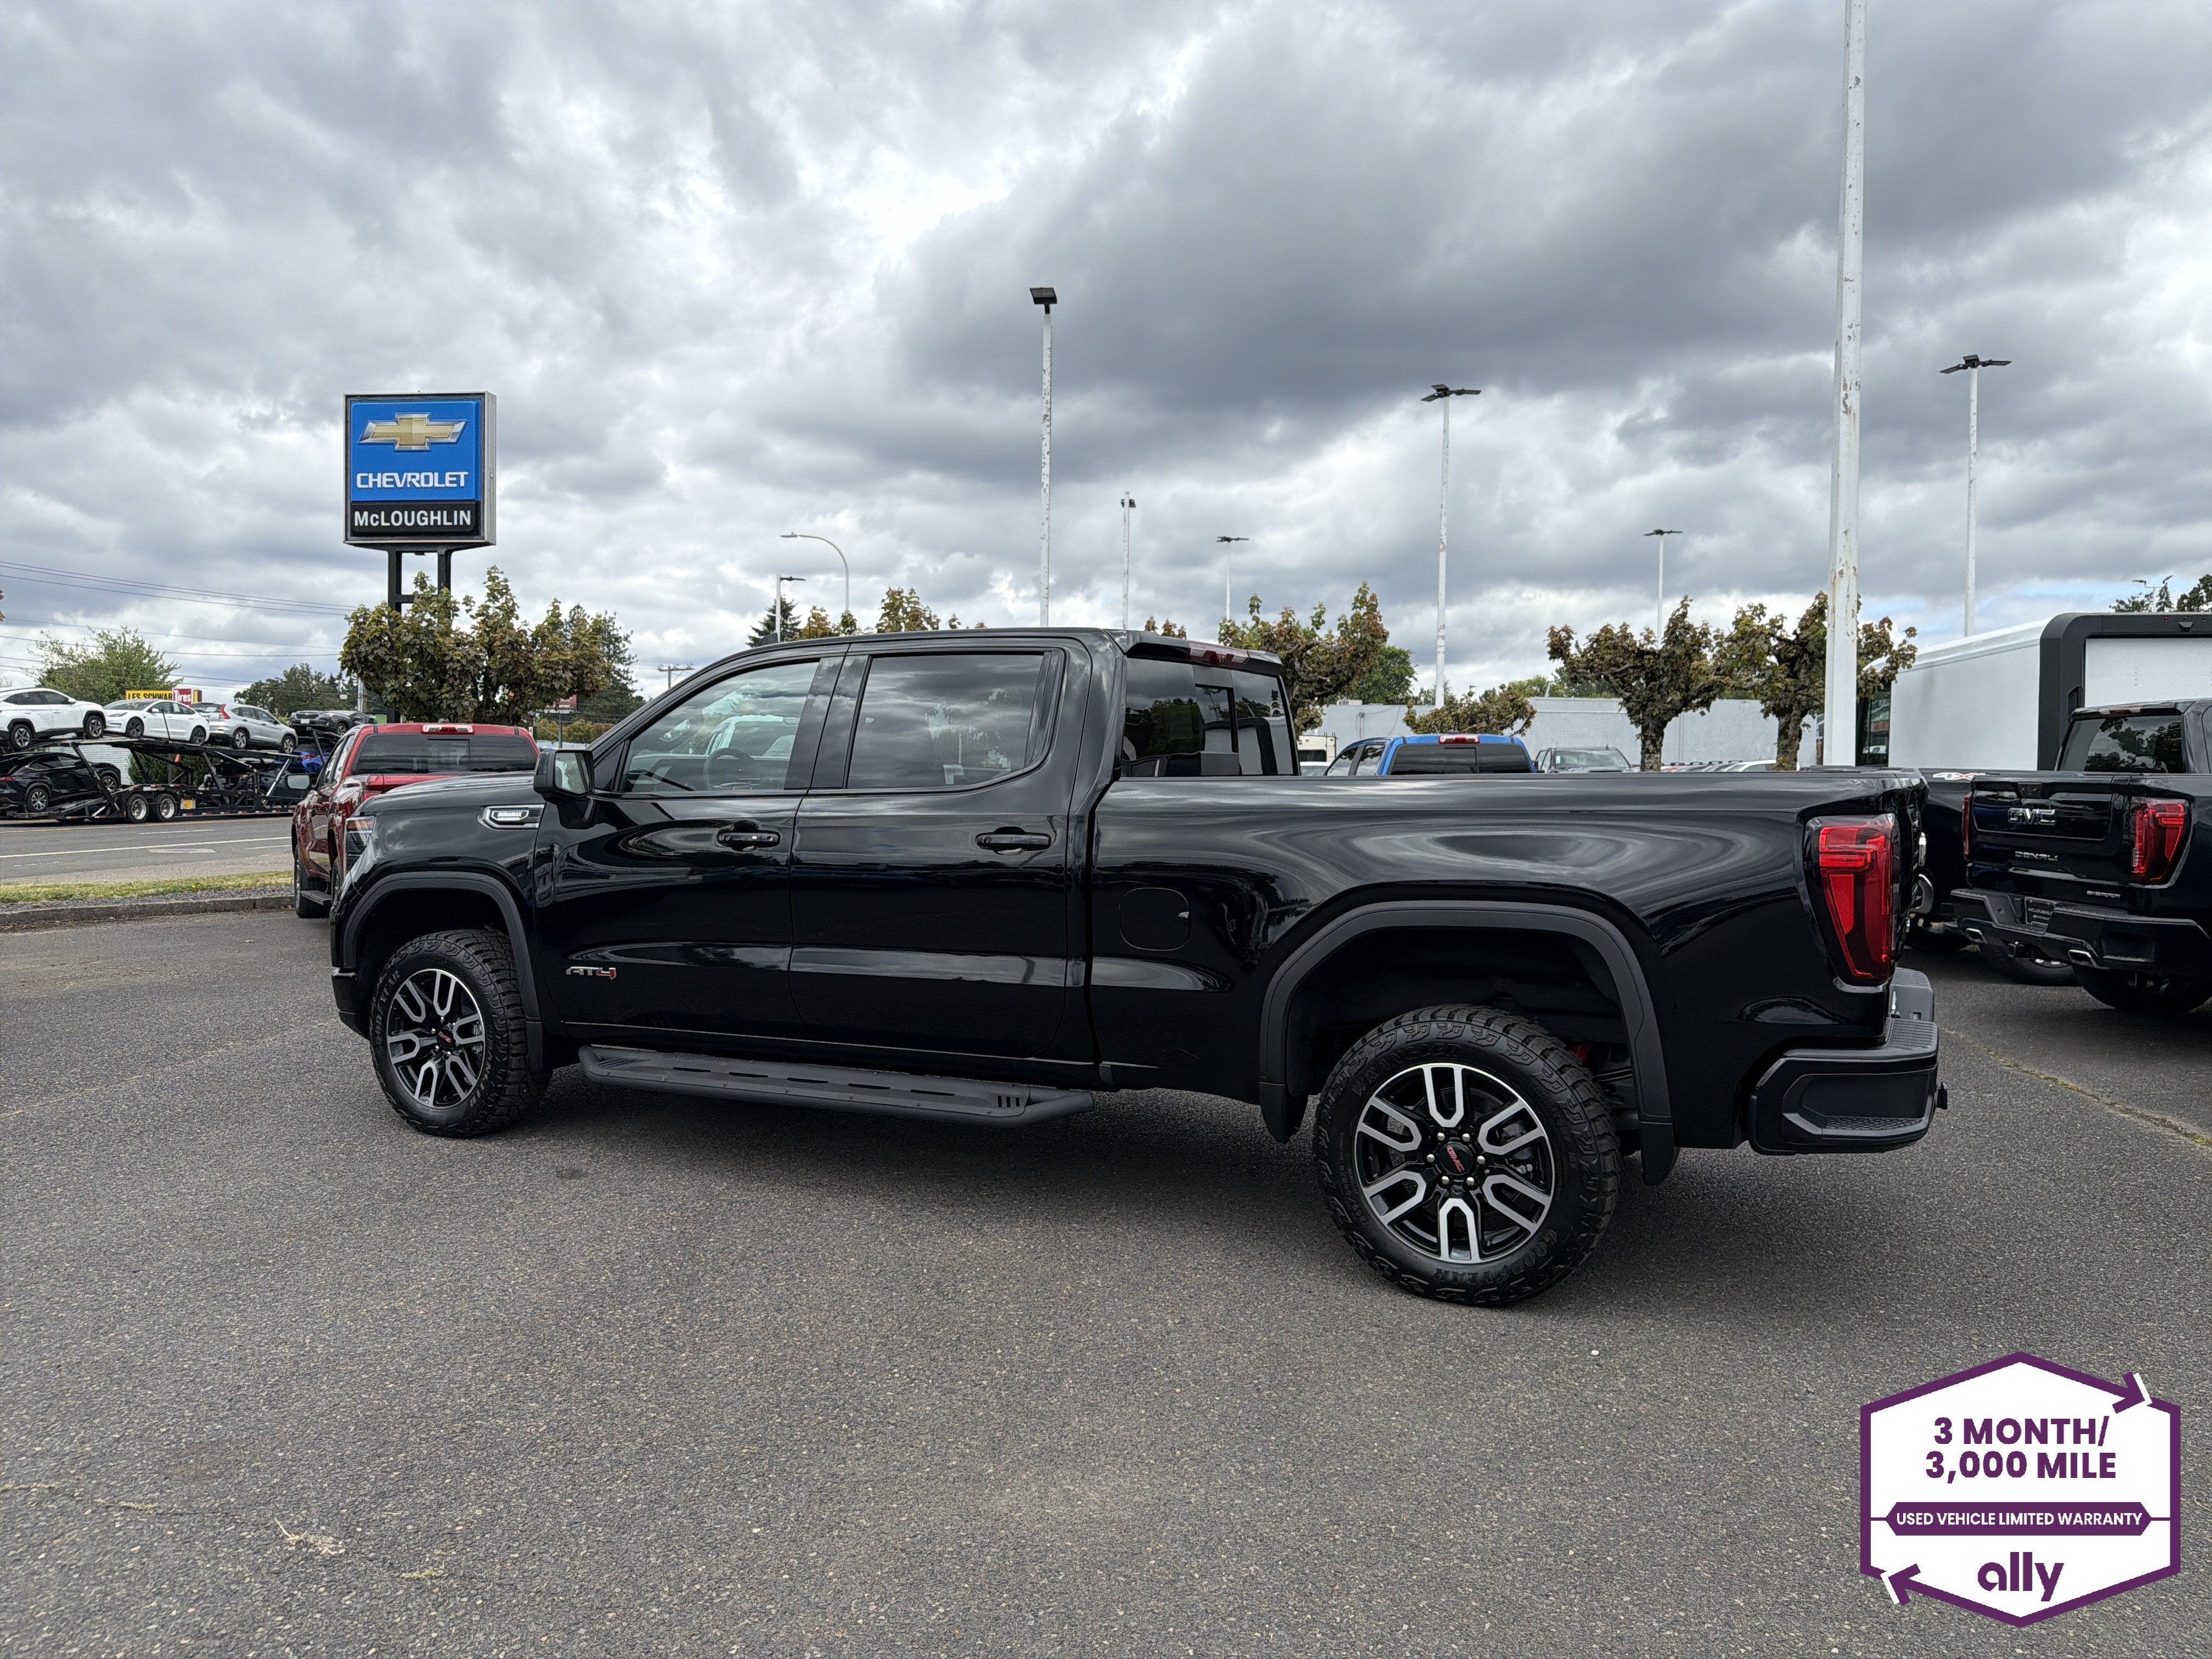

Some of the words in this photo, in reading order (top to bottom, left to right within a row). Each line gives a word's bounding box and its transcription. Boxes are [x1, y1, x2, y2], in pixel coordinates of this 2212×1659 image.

[357, 472, 469, 488] CHEVROLET
[354, 510, 471, 526] McLOUGHLIN
[174, 690, 191, 702] Tires
[2008, 807, 2056, 826] GMC
[565, 966, 617, 980] AT4
[1447, 1146, 1465, 1172] GMC
